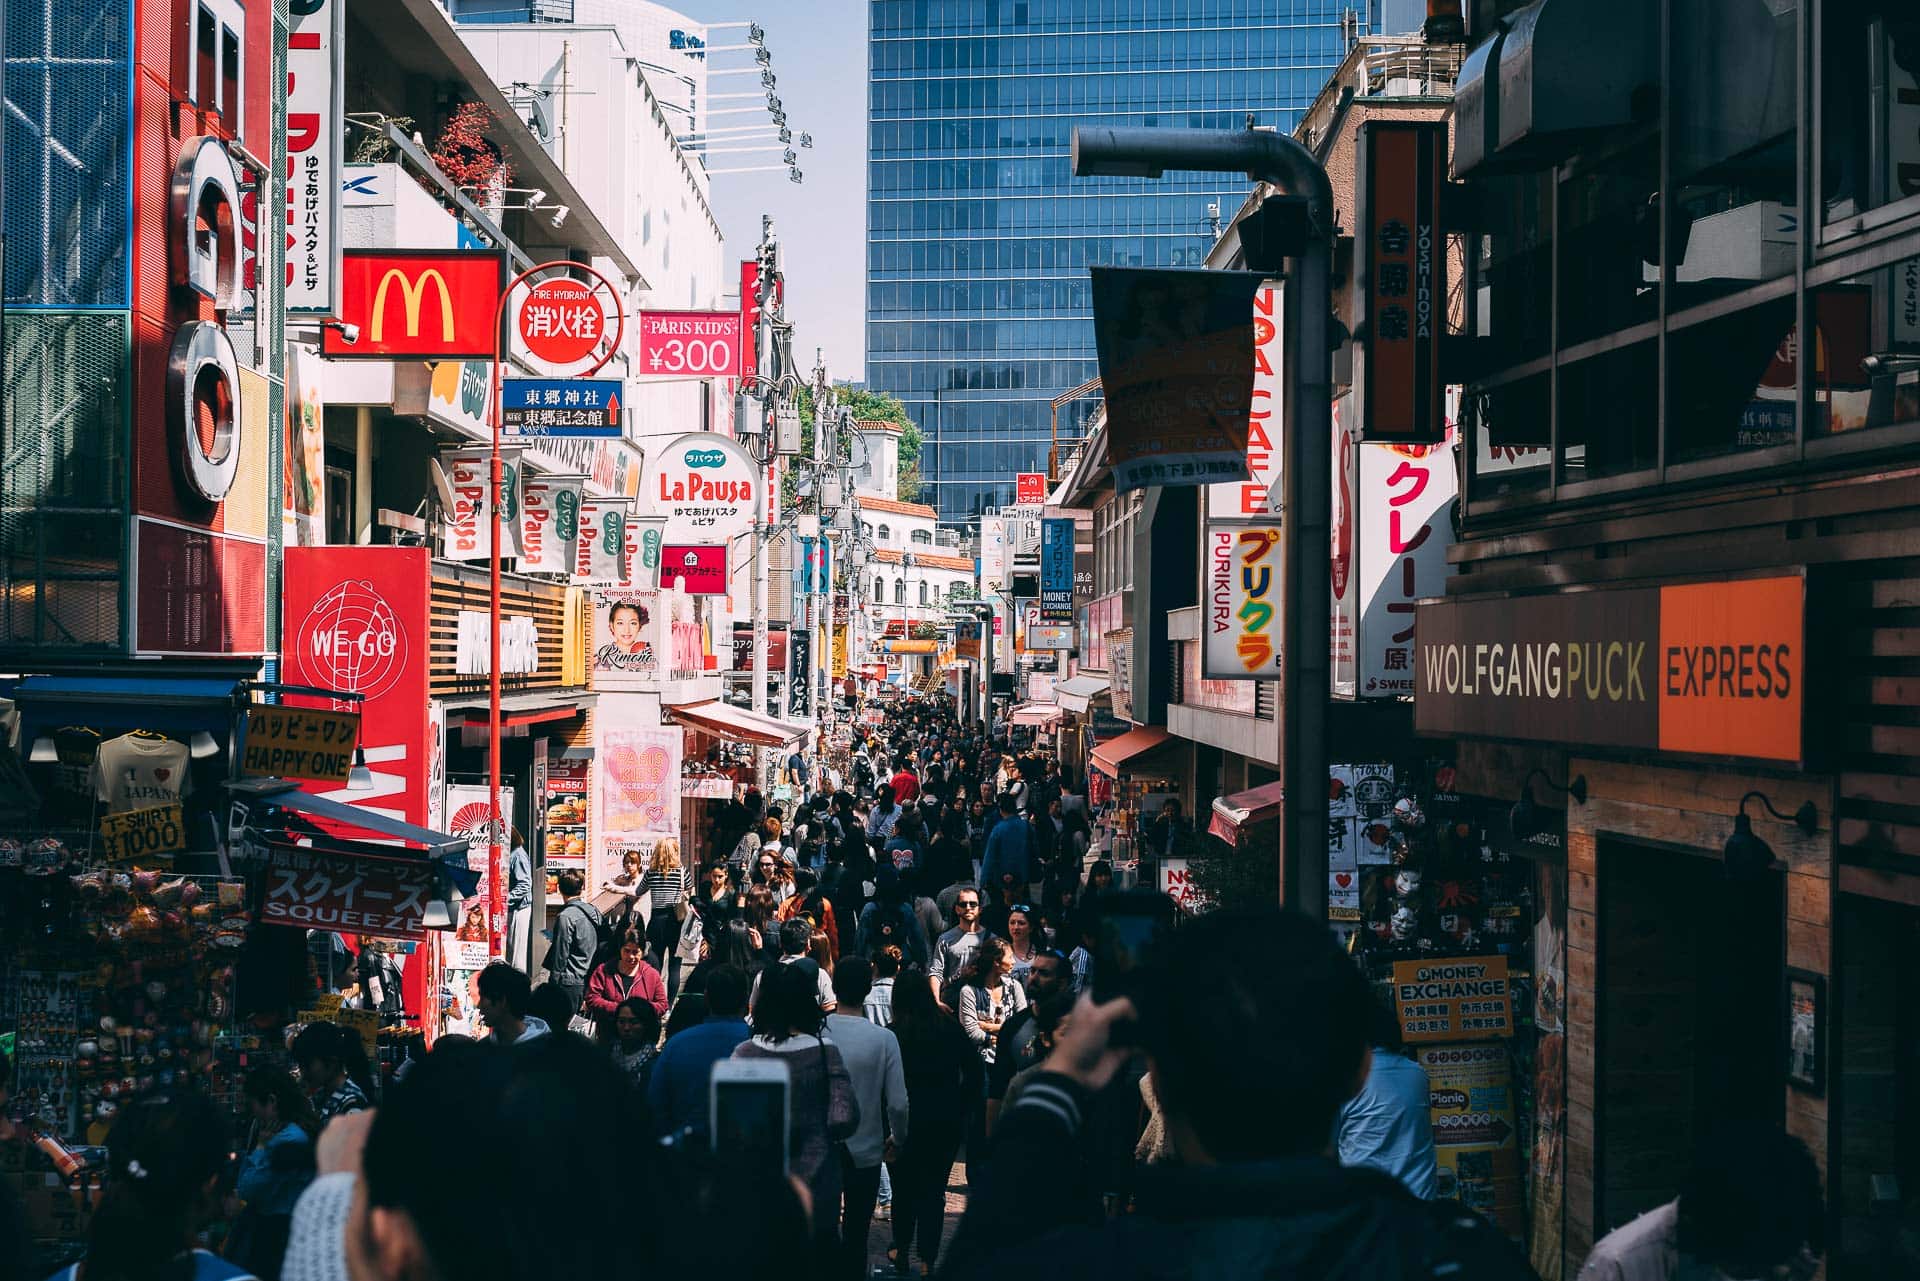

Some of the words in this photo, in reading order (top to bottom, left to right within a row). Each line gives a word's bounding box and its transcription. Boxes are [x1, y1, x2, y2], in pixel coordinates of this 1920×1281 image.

[533, 290, 551, 300] FIRE
[553, 290, 591, 300] HYDRANT
[526, 305, 599, 338] 消火栓
[651, 318, 692, 335] PARIS
[694, 321, 732, 336] KID'S
[649, 339, 730, 372] ¥300
[524, 390, 600, 406] 東郷神社
[524, 409, 603, 427] 東郷記念館
[453, 457, 482, 483] La
[524, 485, 549, 506] La
[660, 473, 685, 501] La
[688, 473, 752, 504] Pausa
[454, 486, 483, 551] Pausa
[525, 509, 549, 564] Pausa
[603, 589, 633, 598] Kimono
[635, 589, 659, 599] Rental
[1214, 532, 1231, 634] PURIKURA
[1042, 602, 1073, 610] EXCHANGE
[1043, 591, 1072, 602] MONEY
[1237, 528, 1281, 672] プリクラ
[311, 630, 349, 658] WE
[358, 630, 396, 658] GO
[598, 644, 655, 669] Kimono
[1379, 679, 1416, 690] SWEE
[1667, 643, 1792, 700] EXPRESS
[245, 745, 307, 776] HAPPY
[311, 752, 348, 778] ONE
[105, 806, 172, 833] T-SHIRT
[107, 822, 180, 860] ¥1000
[266, 901, 425, 933] SQUEEZE
[1431, 966, 1486, 980] MONEY
[1400, 981, 1505, 1000] EXCHANGE
